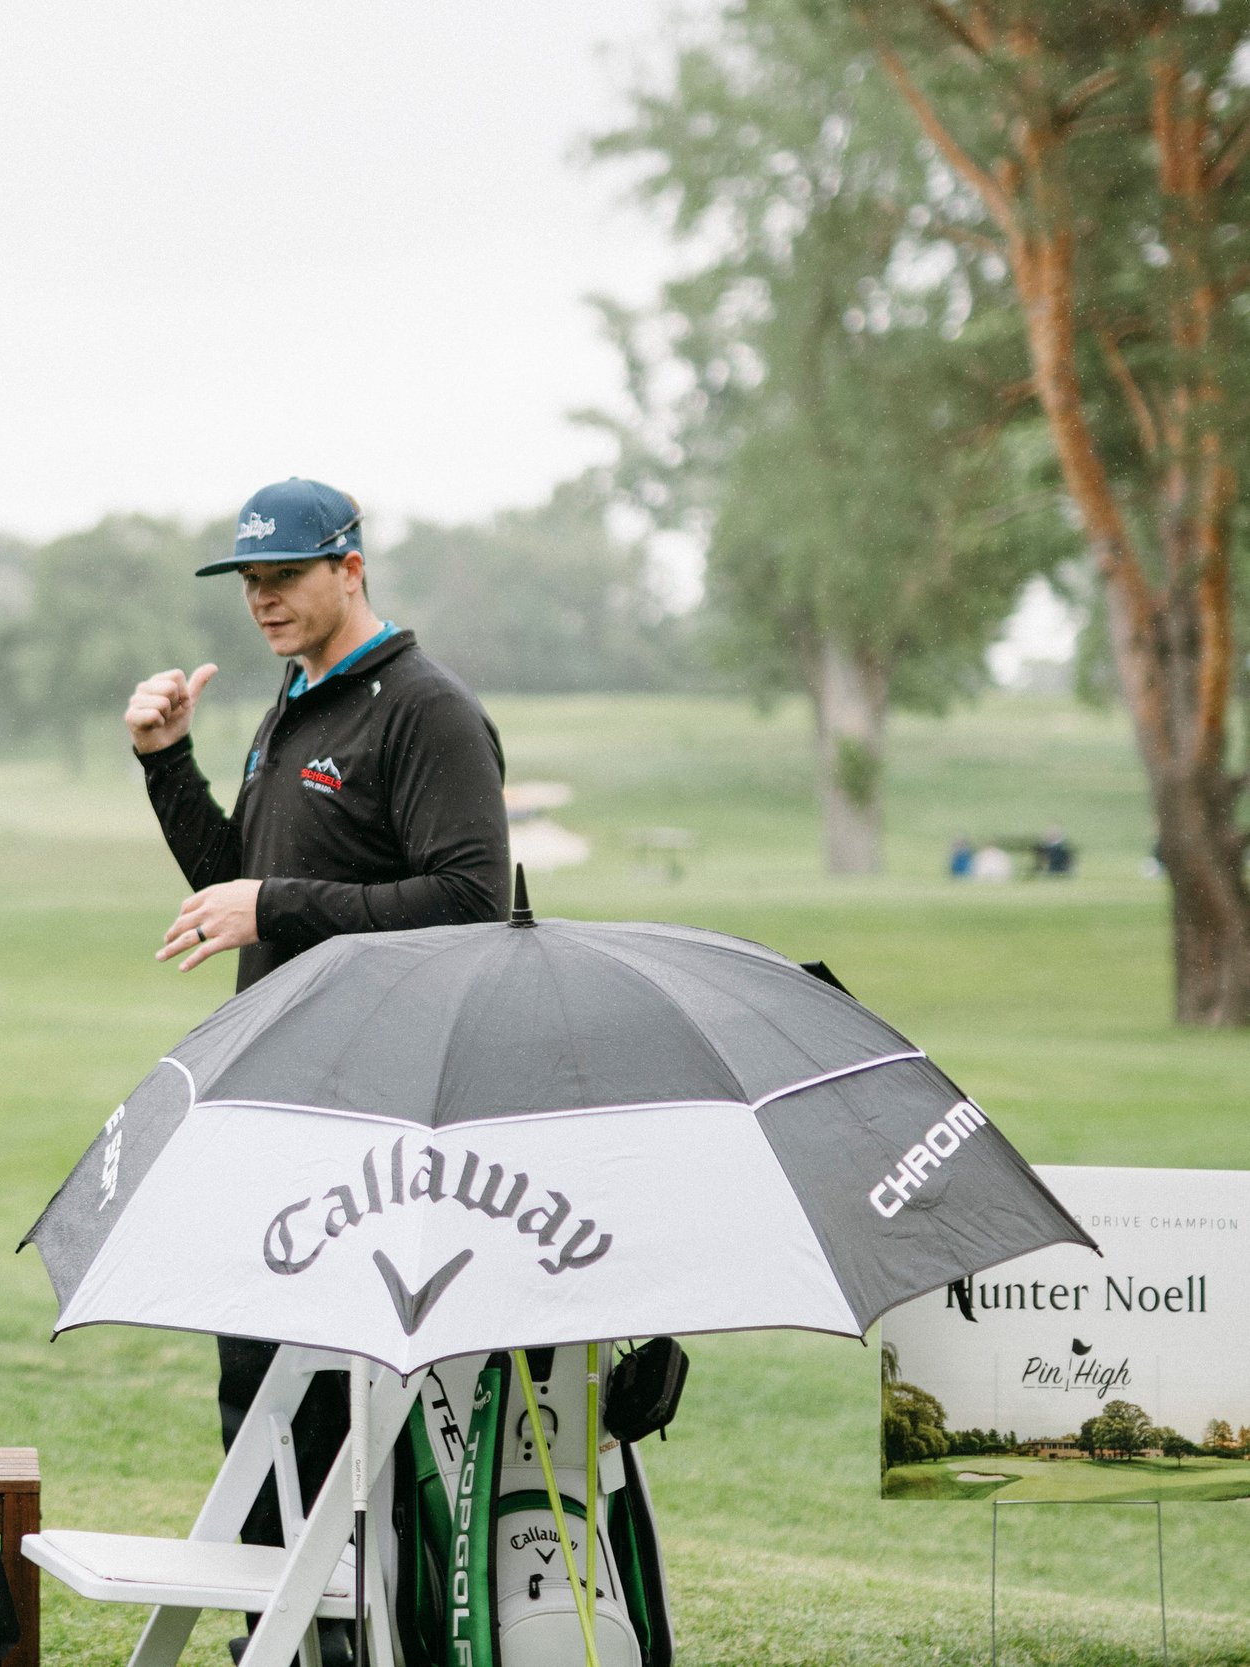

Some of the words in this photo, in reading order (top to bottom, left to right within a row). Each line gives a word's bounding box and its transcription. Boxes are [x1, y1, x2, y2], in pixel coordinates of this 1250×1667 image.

[301, 767, 342, 790] SCHEELS
[870, 1097, 988, 1218] CHROM
[263, 1134, 613, 1275] Callaway
[1092, 1215, 1142, 1228] DRIVE
[1150, 1216, 1239, 1230] CHAMPION
[945, 1274, 1090, 1311] Hunter
[1105, 1274, 1207, 1313] Noell
[1022, 1356, 1063, 1384] Pin
[1073, 1356, 1132, 1399] High
[452, 1431, 481, 1667] TOPGOLF
[511, 1526, 578, 1550] Callawy
